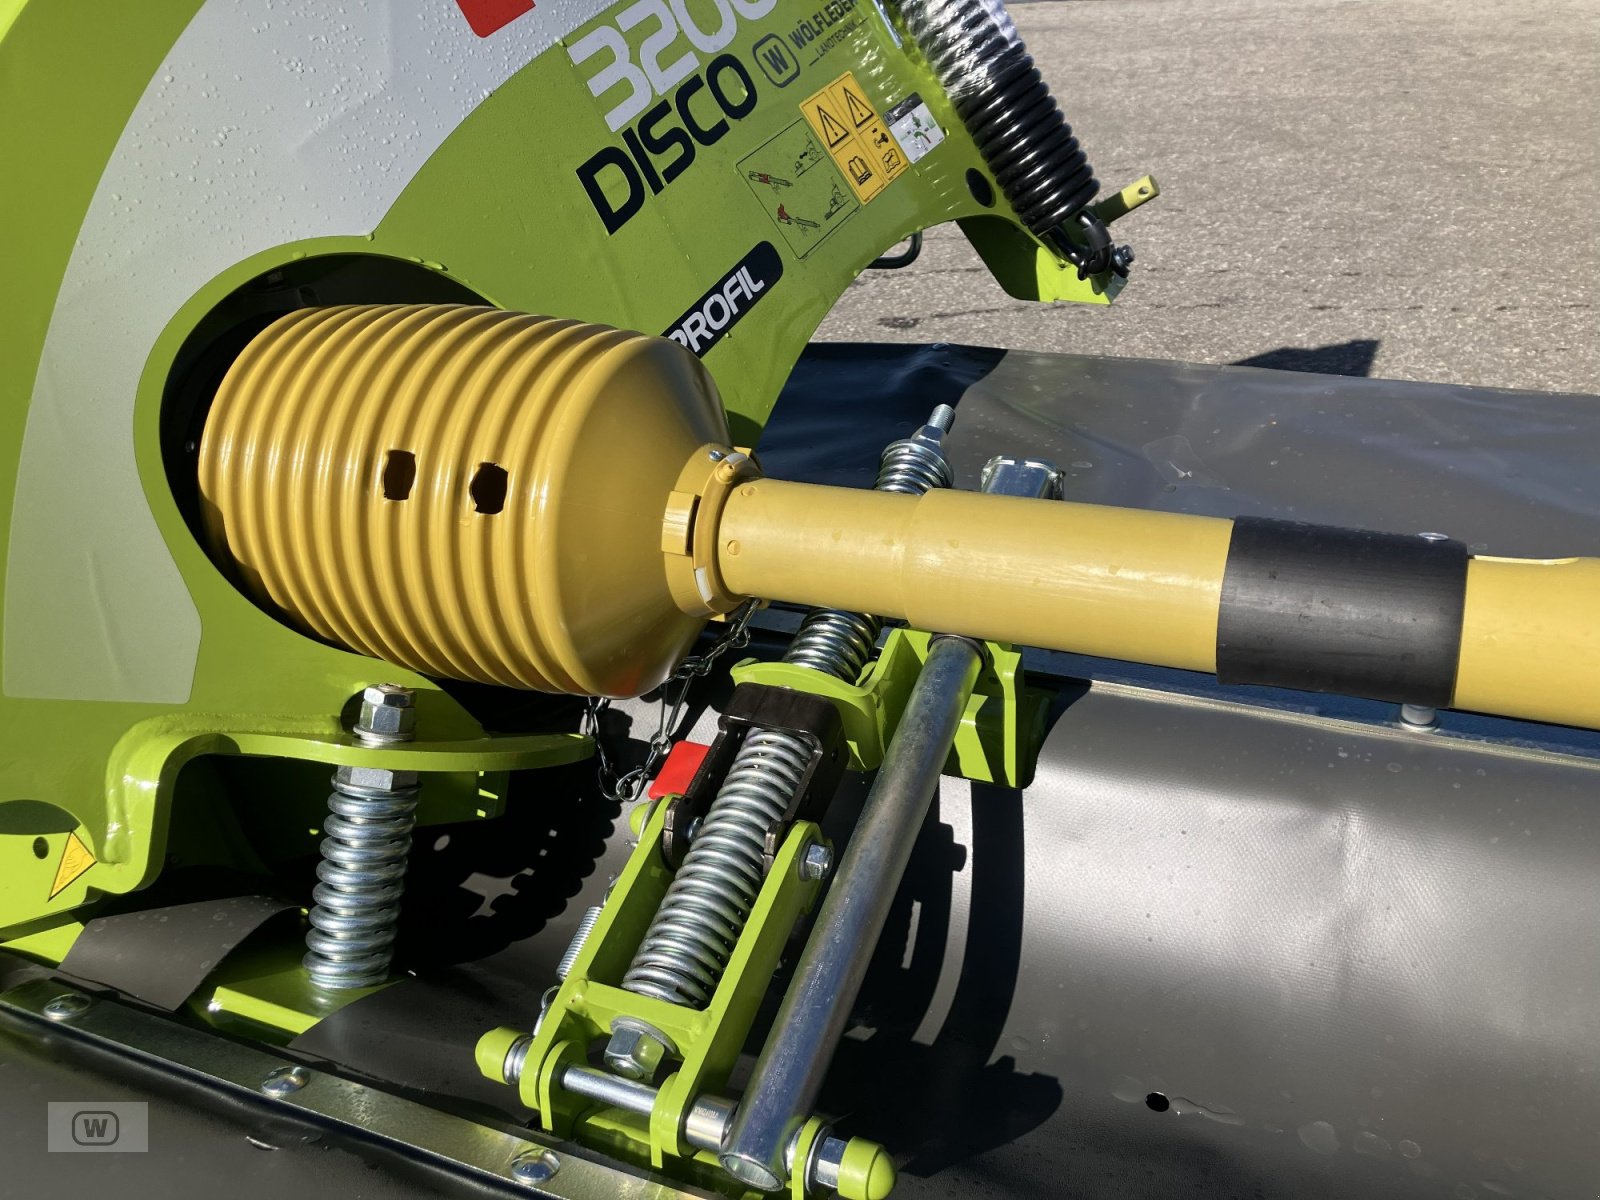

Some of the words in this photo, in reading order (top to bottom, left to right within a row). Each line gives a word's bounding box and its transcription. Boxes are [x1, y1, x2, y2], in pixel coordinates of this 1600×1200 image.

[567, 0, 777, 133] 320
[815, 20, 858, 57] LANDTECHNIK
[575, 54, 758, 236] DISCO
